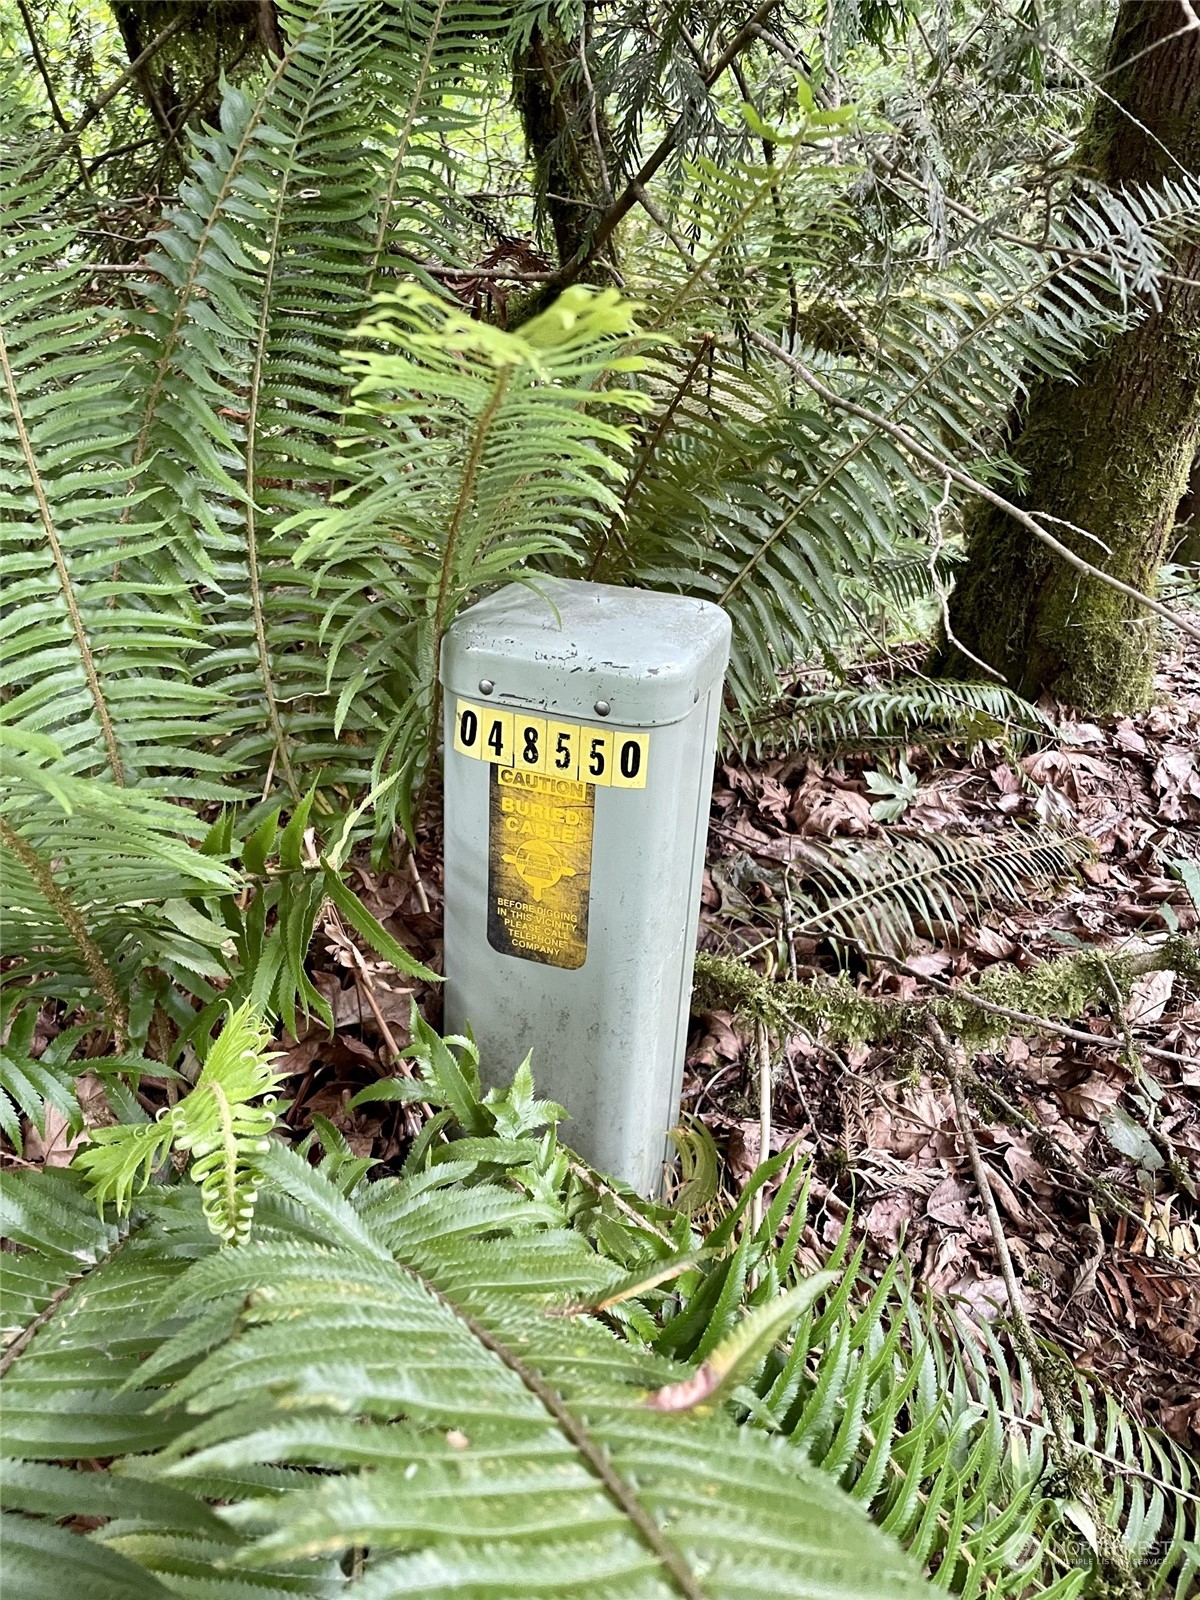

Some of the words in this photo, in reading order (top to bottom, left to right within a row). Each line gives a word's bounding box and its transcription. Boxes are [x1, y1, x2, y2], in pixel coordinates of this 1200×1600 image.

[460, 710, 641, 778] 048550
[500, 769, 584, 798] CAUTION
[501, 796, 580, 826] BURIED
[505, 816, 576, 844] CABLE
[497, 897, 535, 913] BEFORE
[537, 906, 578, 923] DIGGING
[497, 907, 507, 916] IN
[511, 910, 532, 922] THIS
[536, 916, 578, 932] VICINITY
[504, 918, 541, 933] PLEASE
[544, 927, 569, 940] CALL
[508, 928, 565, 948] TELEPHONE
[511, 938, 561, 956] COMPANY
